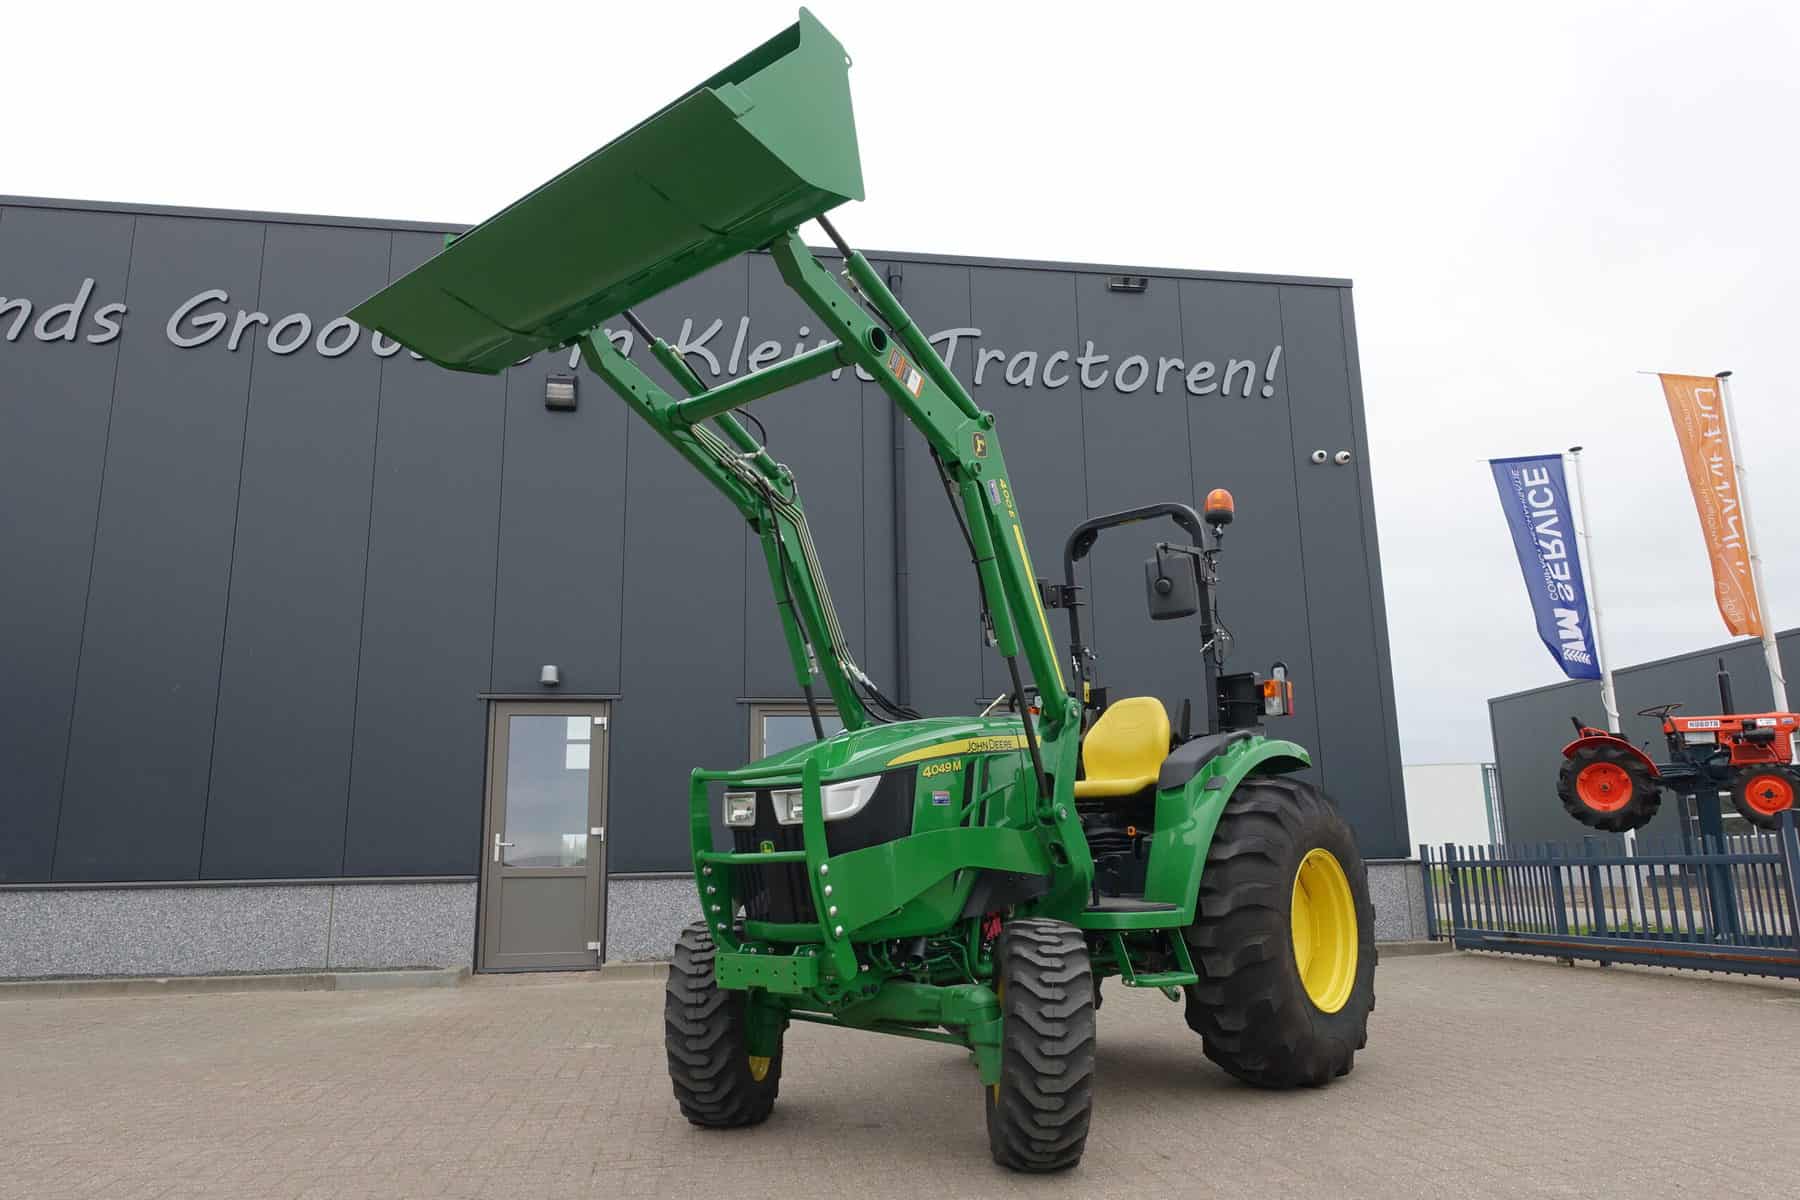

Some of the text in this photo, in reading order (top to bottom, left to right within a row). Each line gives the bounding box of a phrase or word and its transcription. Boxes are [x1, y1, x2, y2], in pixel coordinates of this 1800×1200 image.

[0, 278, 127, 343] nds
[676, 316, 877, 380] Klei
[929, 327, 1281, 398] Tractoren!
[966, 738, 1013, 752] JOHN DEERE
